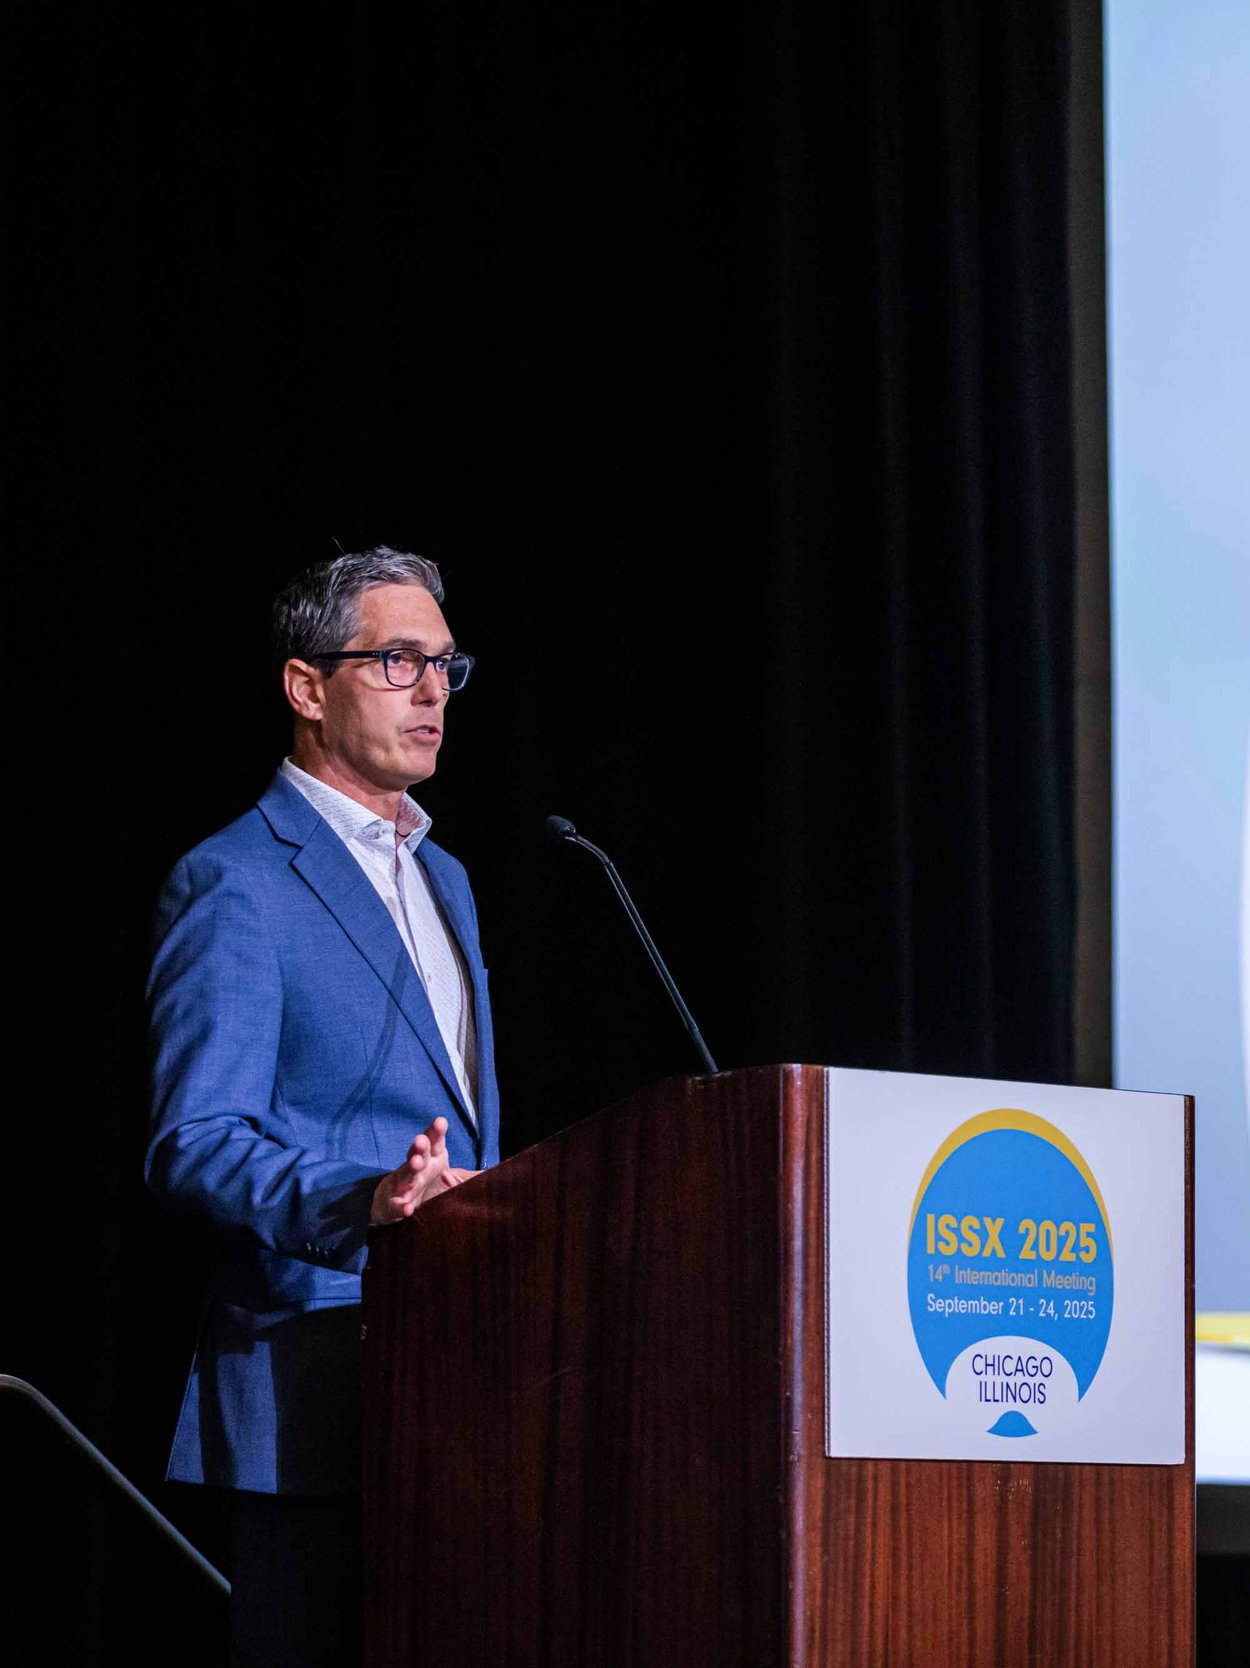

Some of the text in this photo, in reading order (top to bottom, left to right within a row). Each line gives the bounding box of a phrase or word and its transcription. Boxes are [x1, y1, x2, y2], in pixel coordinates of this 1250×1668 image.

[926, 1213, 1097, 1263] ISSX 2025
[927, 1263, 1096, 1296] 14th International Meeting
[927, 1293, 1004, 1317] September
[1009, 1297, 1024, 1316] 21
[1038, 1298, 1059, 1320] 24,
[1063, 1300, 1096, 1319] 2025
[971, 1353, 1053, 1379] CHICAGO
[978, 1380, 1047, 1405] ILLINOIS
